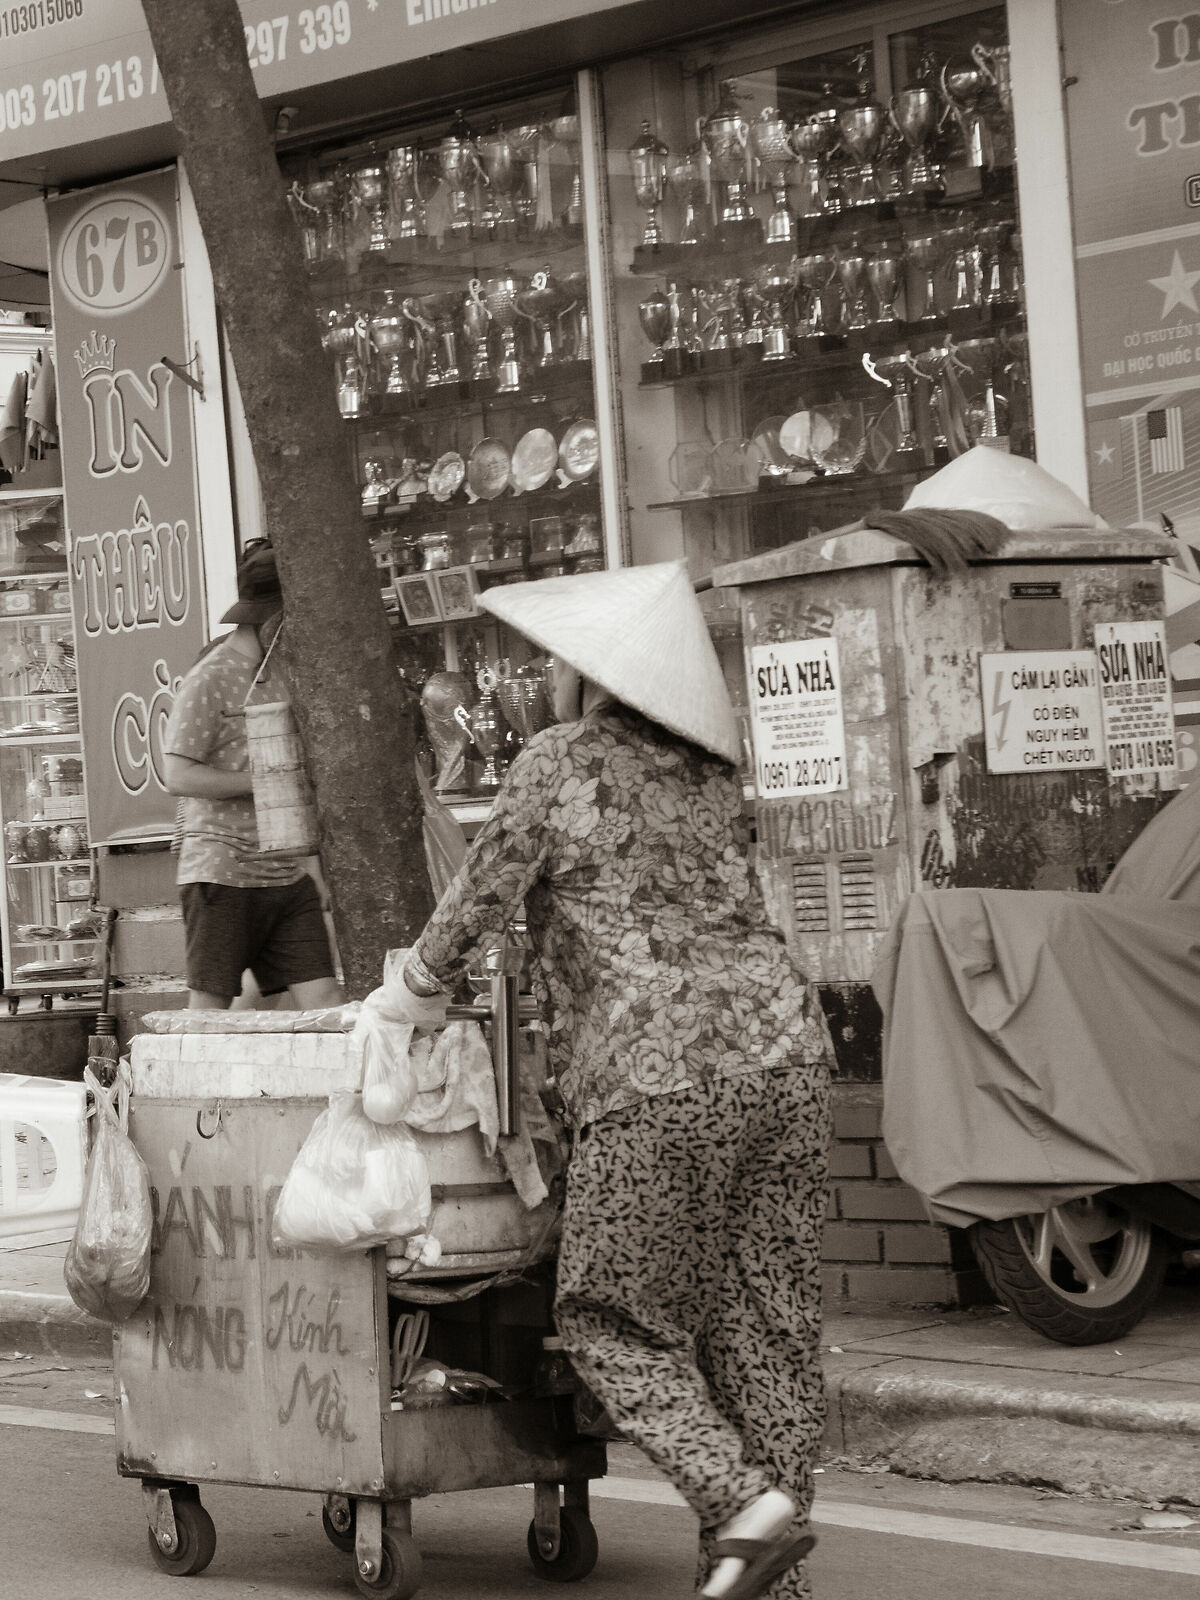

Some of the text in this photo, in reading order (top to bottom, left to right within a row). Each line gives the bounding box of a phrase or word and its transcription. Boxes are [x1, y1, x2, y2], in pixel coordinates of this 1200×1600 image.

[42, 70, 88, 121] 207
[95, 55, 143, 107] 213
[244, 16, 289, 69] 297
[298, 0, 351, 54] 339
[1127, 355, 1154, 374] HỌC
[83, 362, 173, 478] IN
[74, 495, 190, 637] THÊU
[757, 649, 835, 698] SỬA NHÀ
[1011, 664, 1038, 690] CẤM
[1041, 669, 1060, 693] LẠI
[1100, 627, 1166, 683] SỬA NHÀ
[1027, 729, 1059, 743] NGUY
[1033, 704, 1079, 723] CÓ ĐIỆN
[1023, 745, 1095, 765] CHẾT NGƯỜI
[152, 1276, 246, 1374] NÓNG
[266, 1281, 350, 1356] Kính
